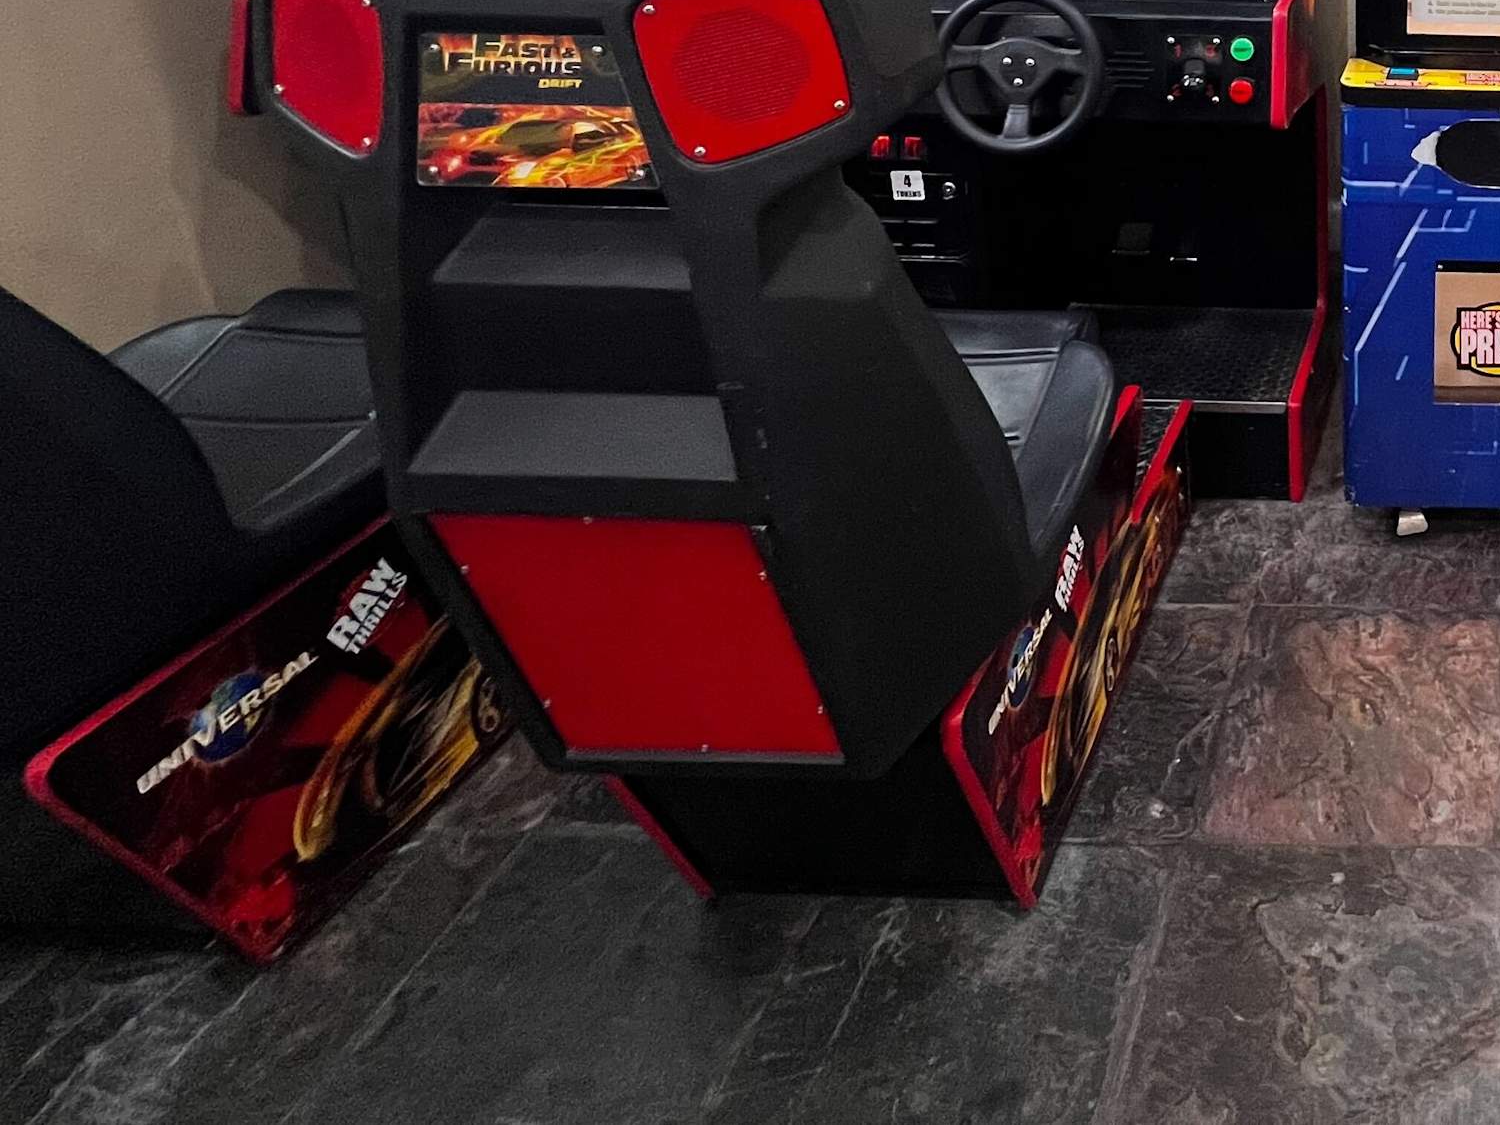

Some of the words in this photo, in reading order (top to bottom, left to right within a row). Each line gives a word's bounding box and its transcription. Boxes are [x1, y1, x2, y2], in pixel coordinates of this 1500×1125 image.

[444, 50, 582, 75] FURIOUS
[537, 77, 583, 89] DRIFT
[904, 174, 912, 188] 4
[326, 556, 398, 653] RAW
[345, 570, 408, 655] THRILLS
[136, 650, 320, 795] UNIVERSAL
